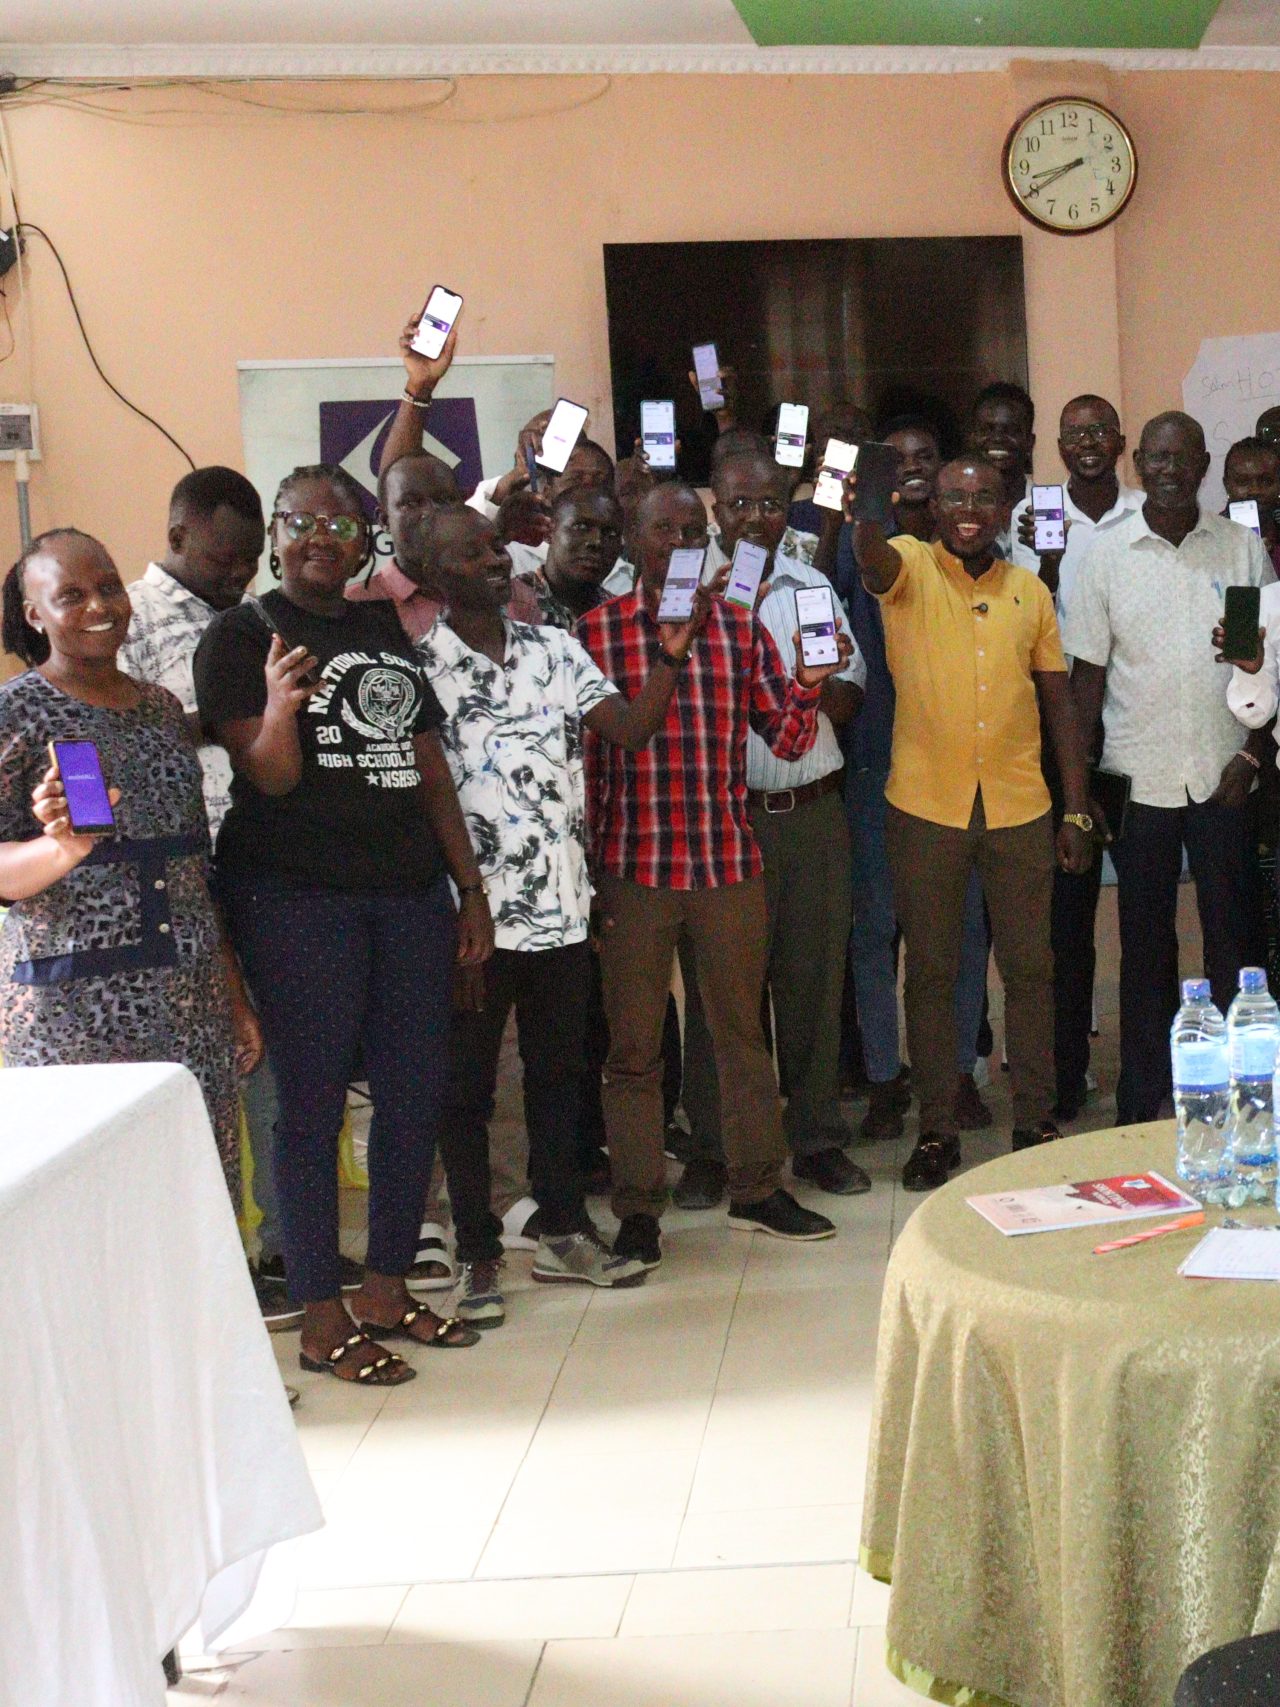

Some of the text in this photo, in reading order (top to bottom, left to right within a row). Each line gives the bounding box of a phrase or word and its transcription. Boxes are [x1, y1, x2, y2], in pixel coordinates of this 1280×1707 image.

[1040, 120, 1054, 135] 11
[1061, 111, 1078, 128] 12
[1088, 118, 1095, 134] 1
[1025, 137, 1040, 153] 10
[1103, 134, 1113, 151] 2
[1019, 159, 1030, 175] 9
[1111, 156, 1122, 173] 3
[1029, 183, 1040, 198] 8
[1105, 178, 1116, 196] 4
[1046, 199, 1056, 215] 7
[1068, 204, 1079, 220] 6
[1090, 197, 1101, 213] 5
[308, 651, 378, 715] NATIONAL
[316, 725, 342, 744] 20
[317, 753, 353, 768] HIGH
[356, 752, 406, 768] SCHOOL
